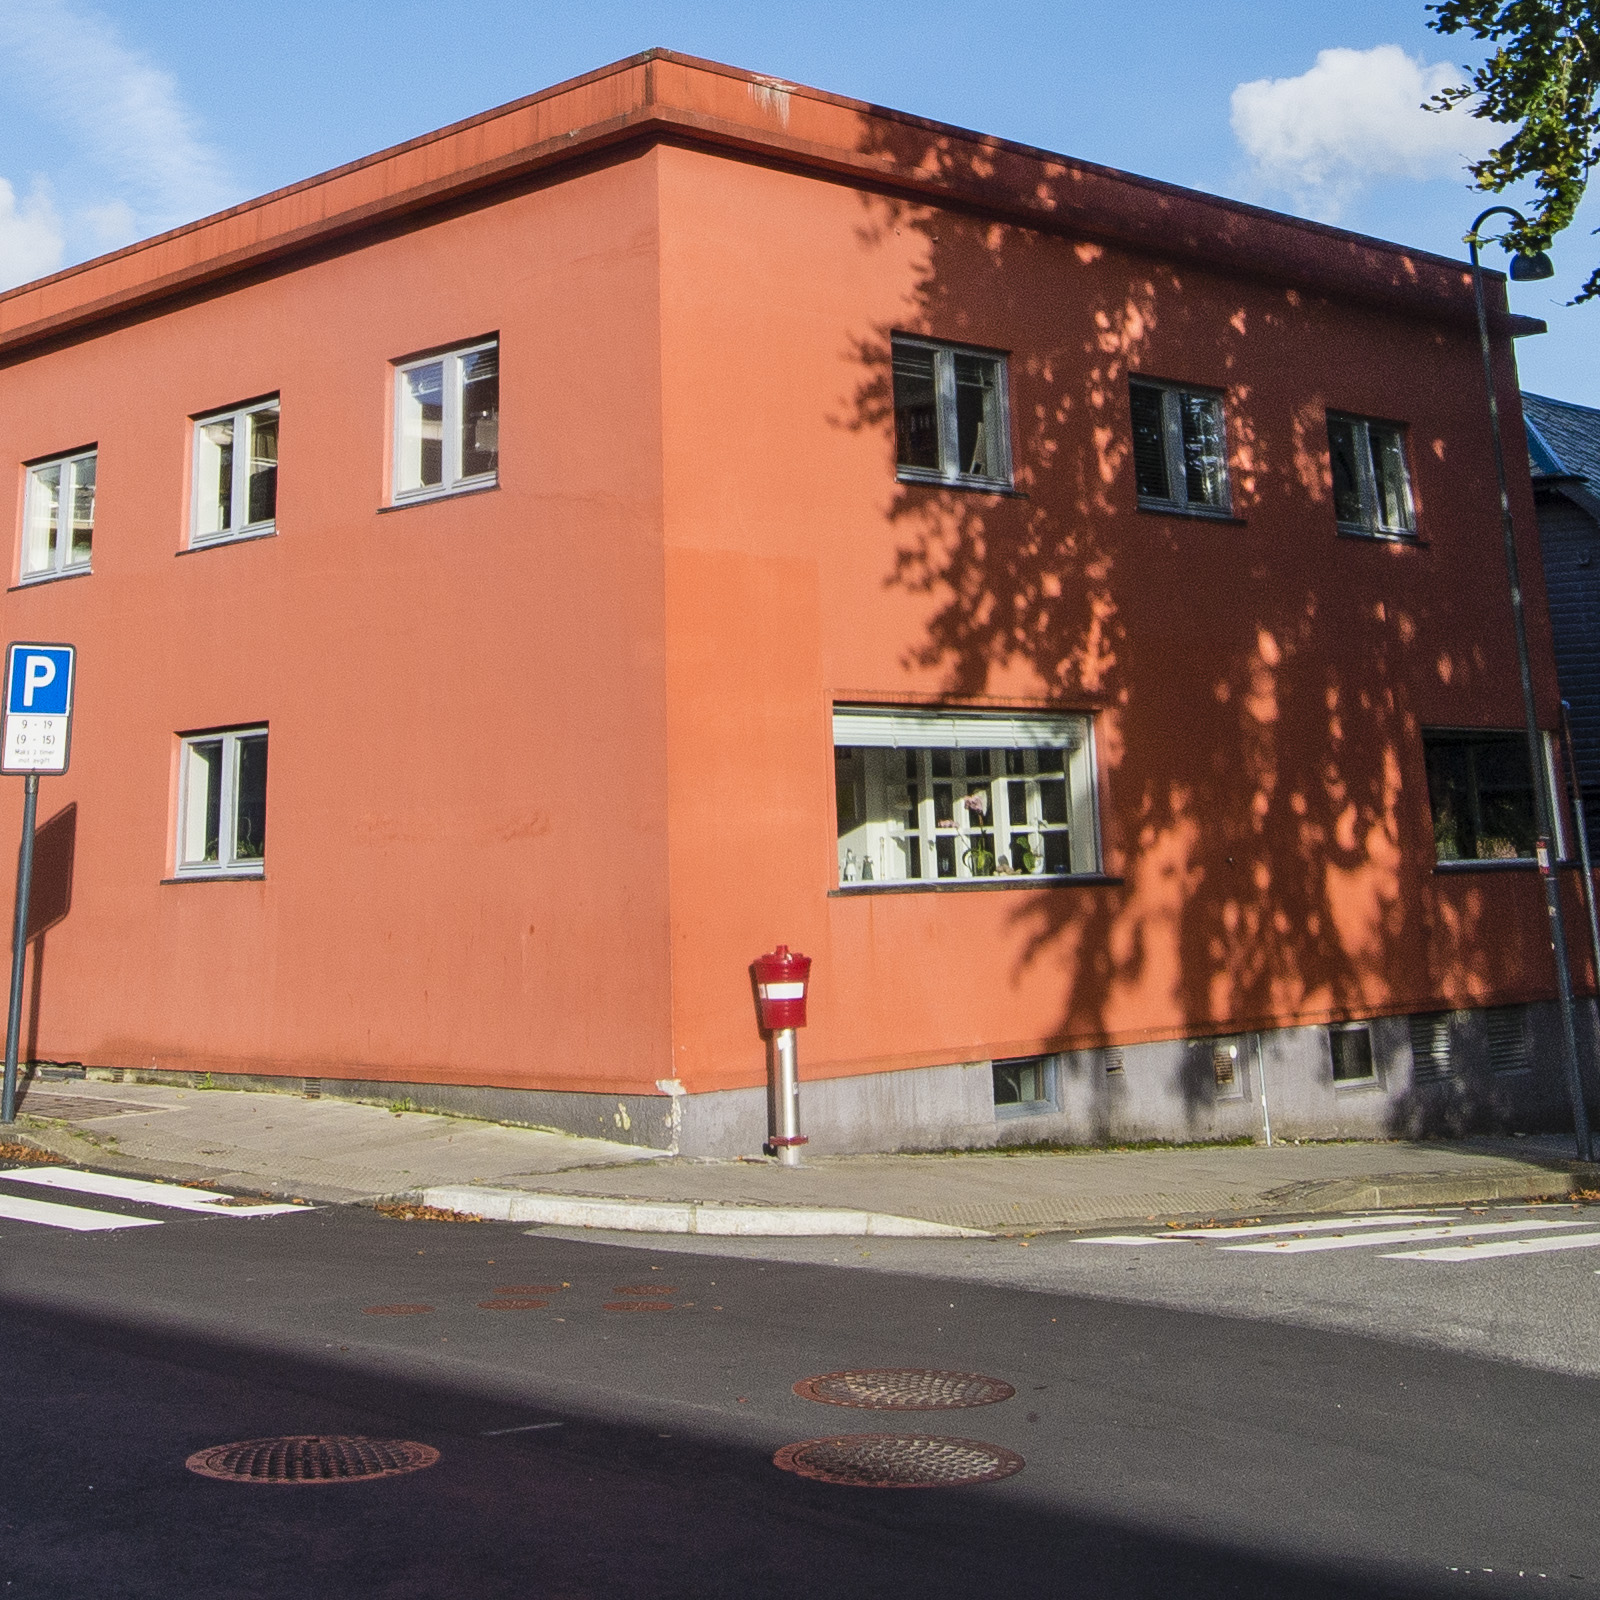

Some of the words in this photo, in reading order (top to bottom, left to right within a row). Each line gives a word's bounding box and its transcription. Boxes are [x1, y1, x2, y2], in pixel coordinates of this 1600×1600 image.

[23, 655, 56, 707] P
[22, 719, 28, 729] 9
[43, 720, 53, 729] 19
[16, 734, 27, 745] (9
[42, 735, 56, 745] 15)
